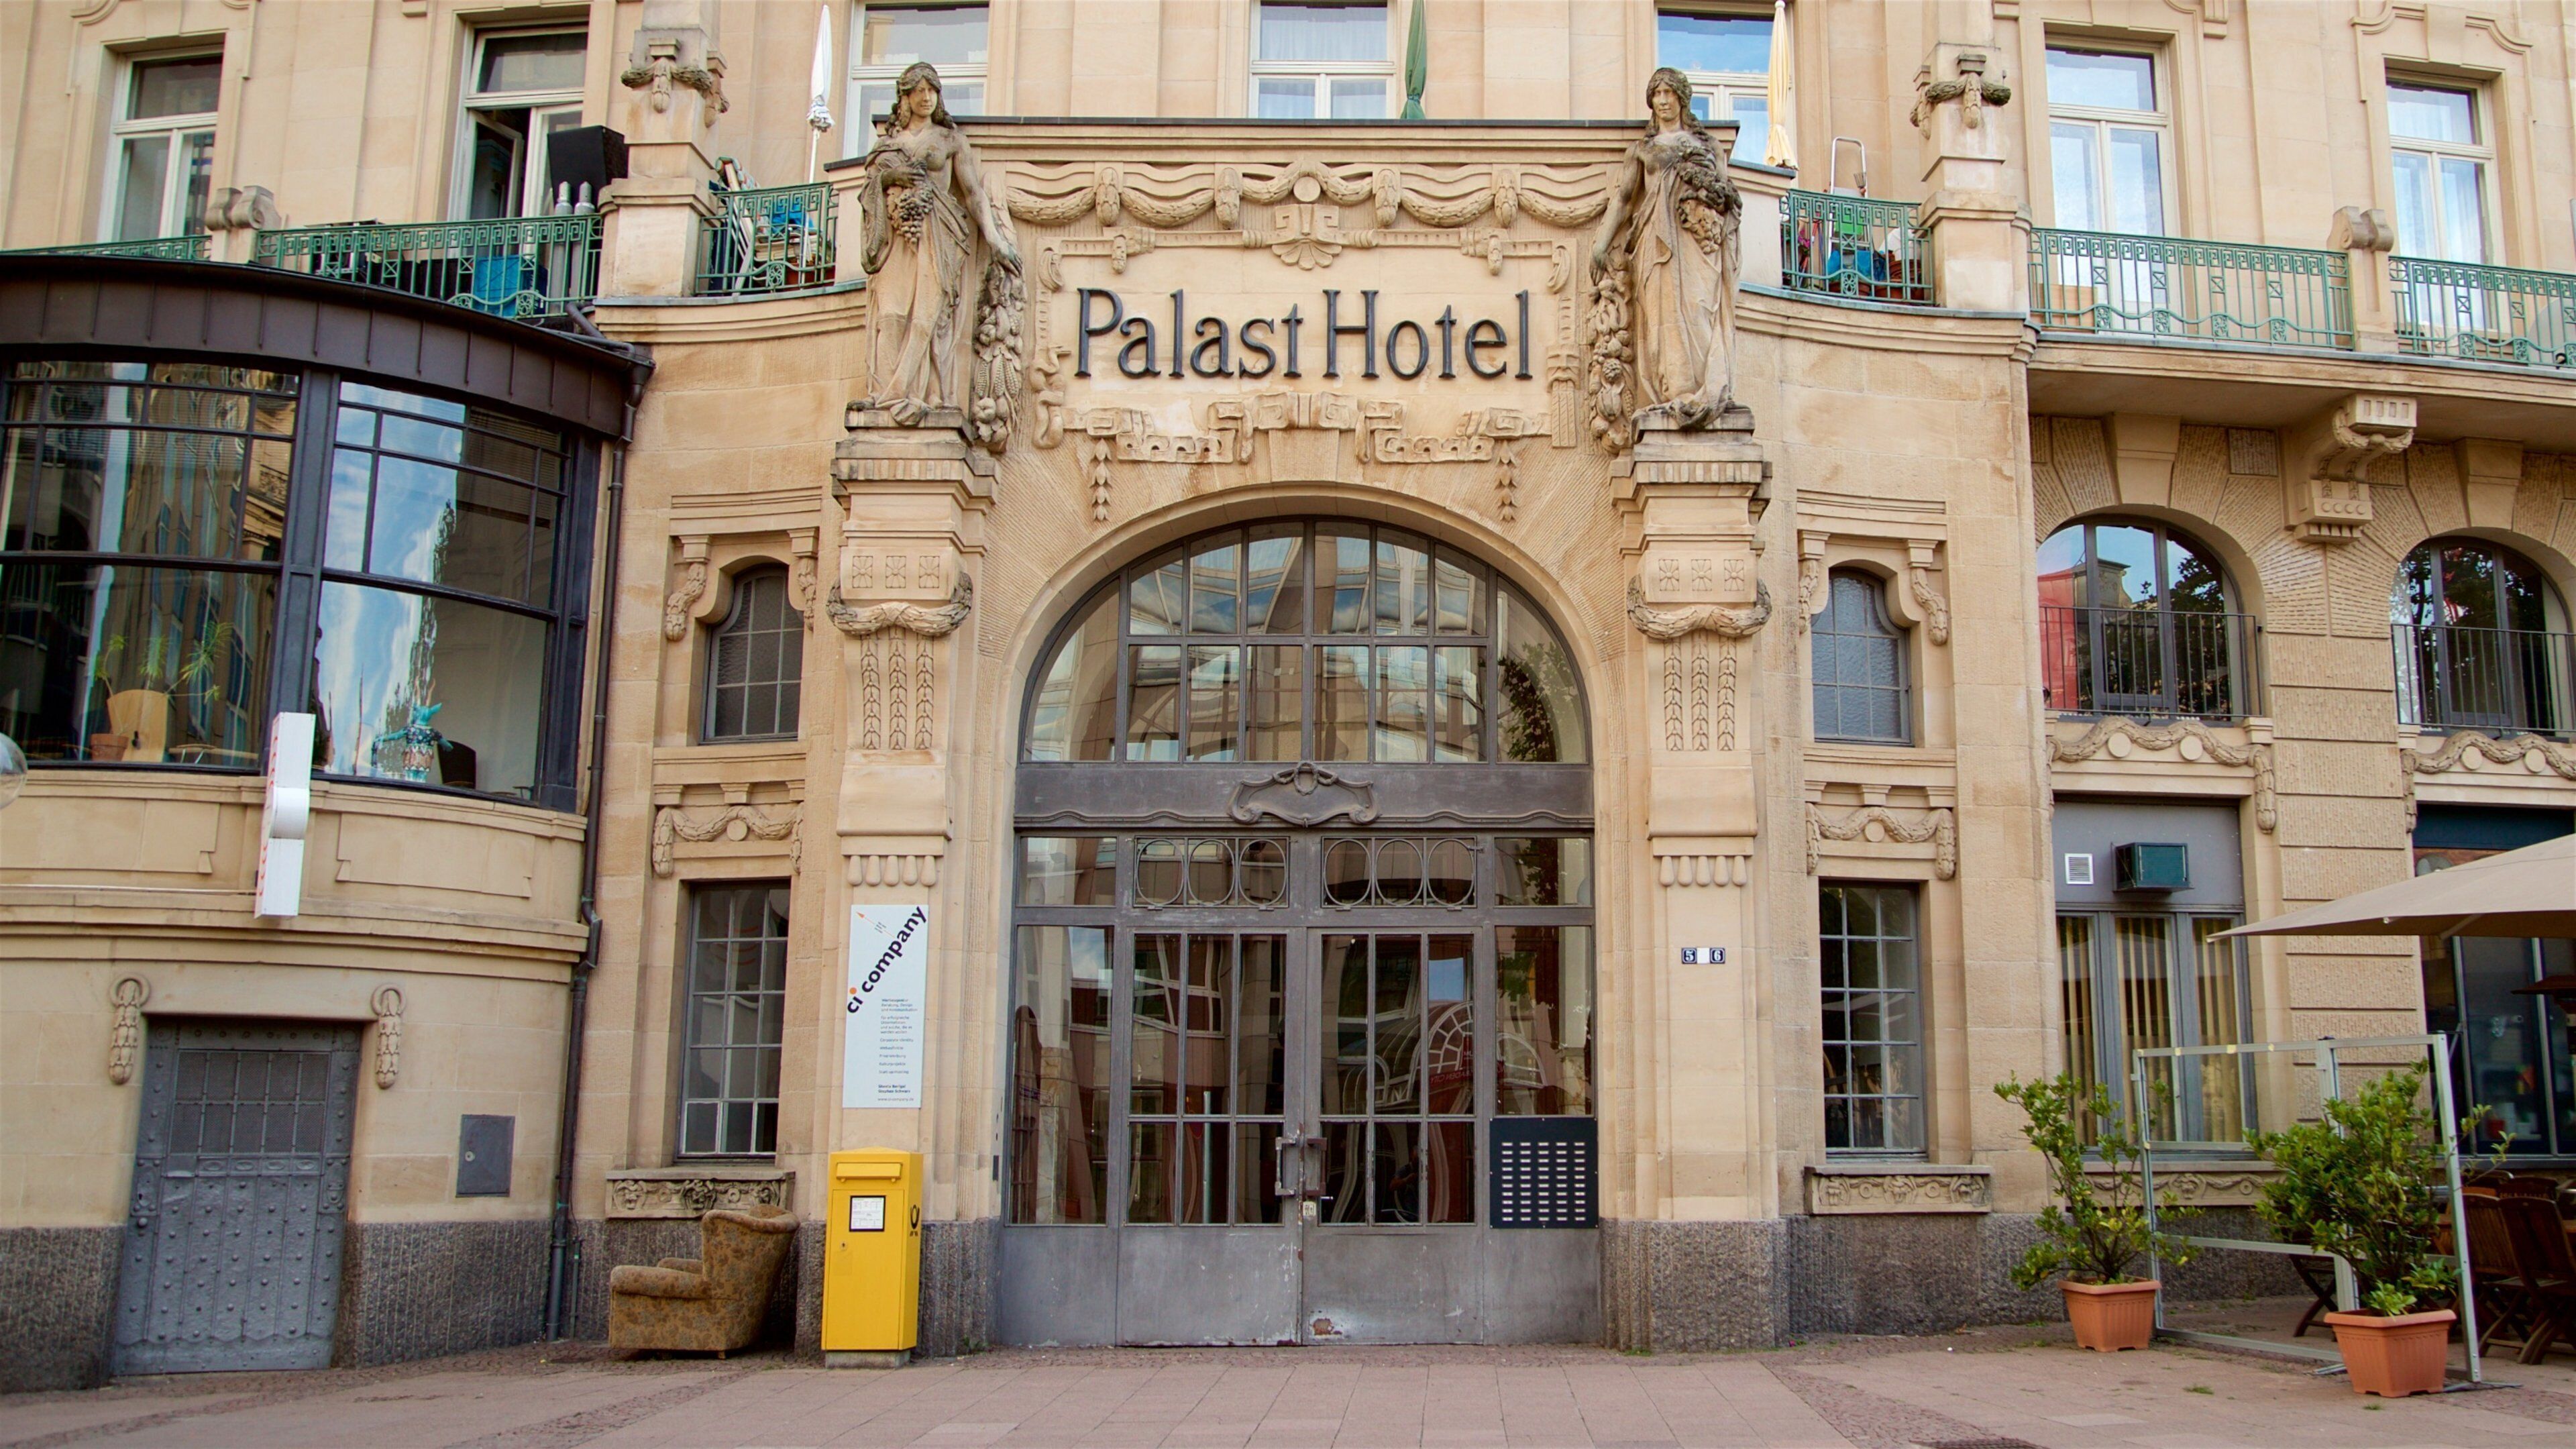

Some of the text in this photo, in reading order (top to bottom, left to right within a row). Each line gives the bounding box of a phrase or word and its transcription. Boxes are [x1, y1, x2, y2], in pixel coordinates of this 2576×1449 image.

[1073, 287, 1534, 380] Palast Hotel
[847, 987, 863, 1014] ci
[861, 906, 927, 993] company
[1685, 950, 1721, 961] 5 6
